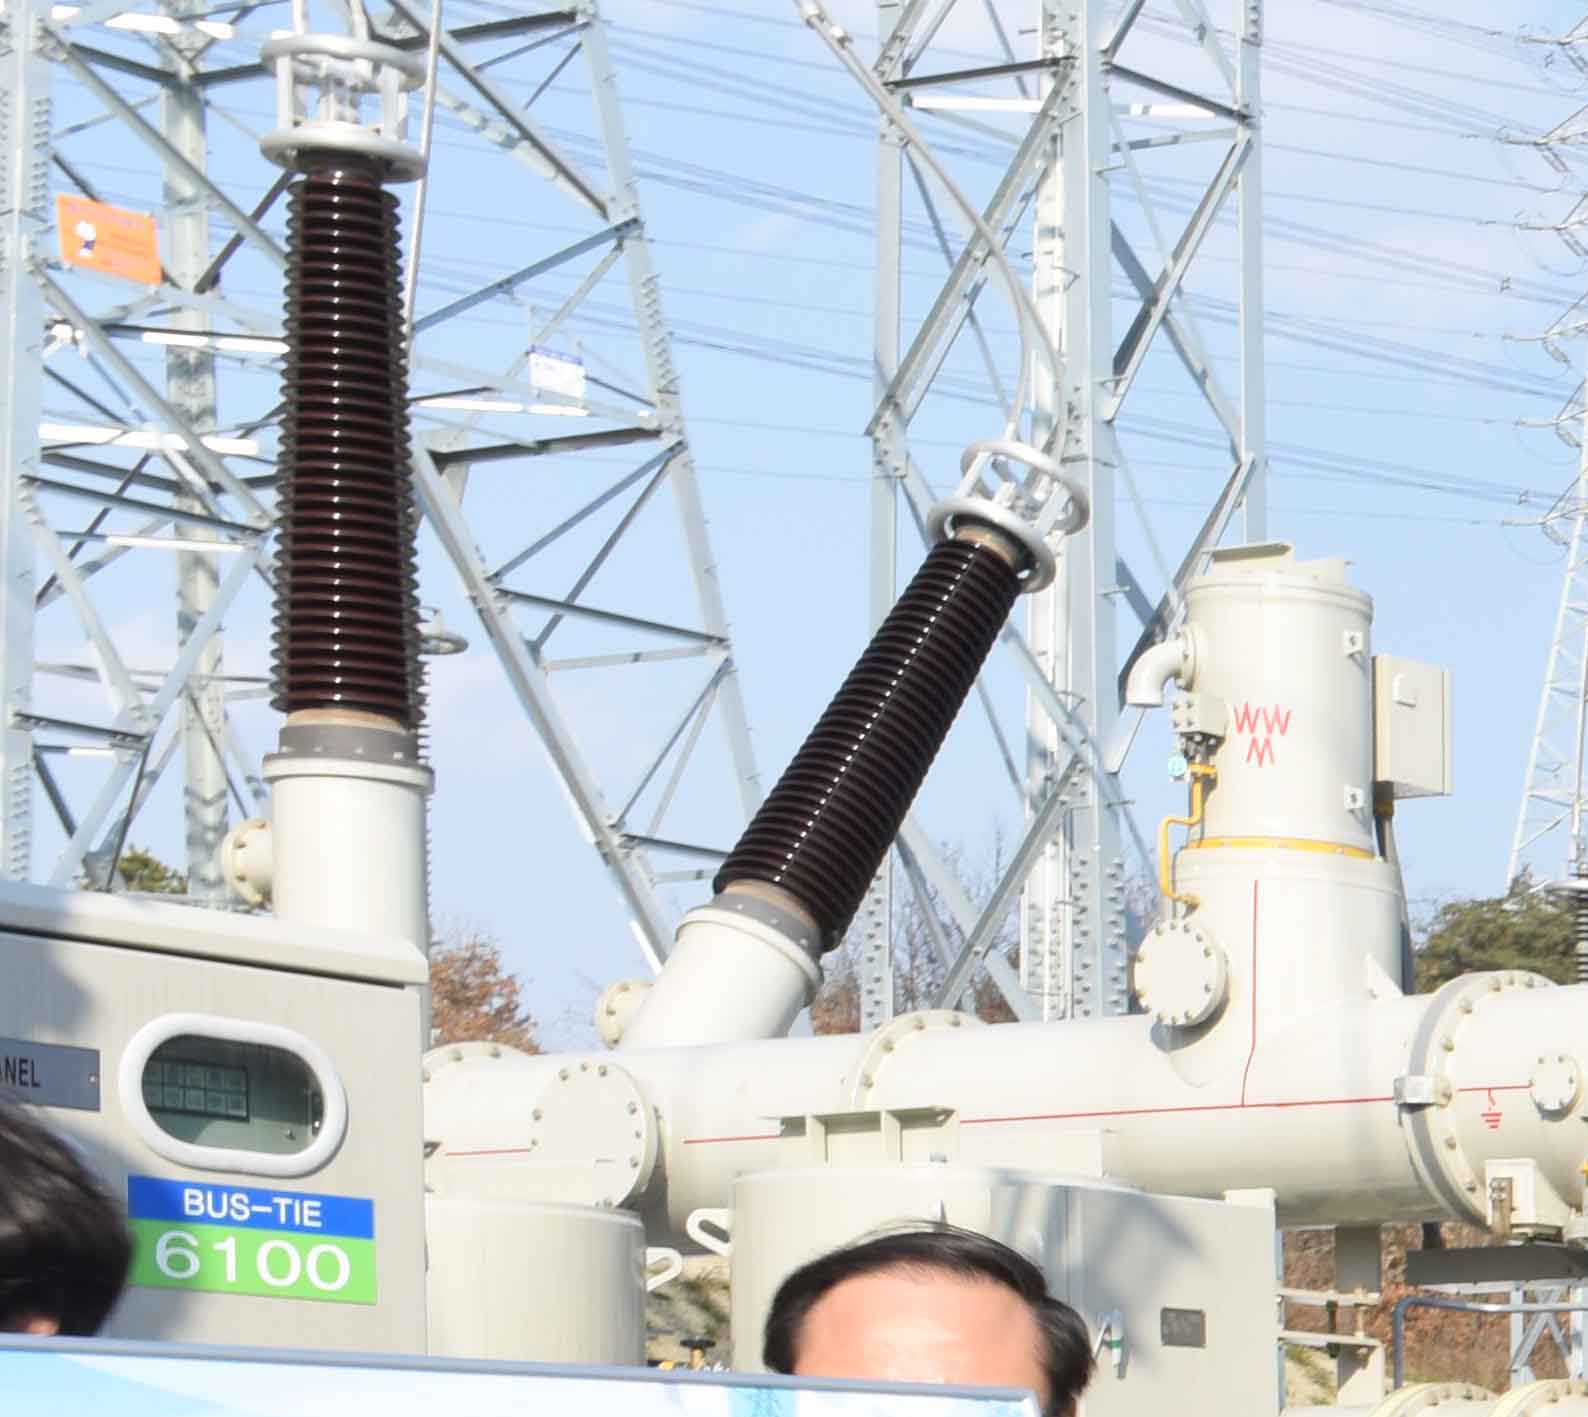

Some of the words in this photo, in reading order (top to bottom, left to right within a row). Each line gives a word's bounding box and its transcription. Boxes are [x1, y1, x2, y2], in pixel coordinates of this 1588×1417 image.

[0, 1055, 41, 1087] NEL
[184, 1187, 322, 1228] BUS-TIE
[156, 1230, 351, 1292] 6100
